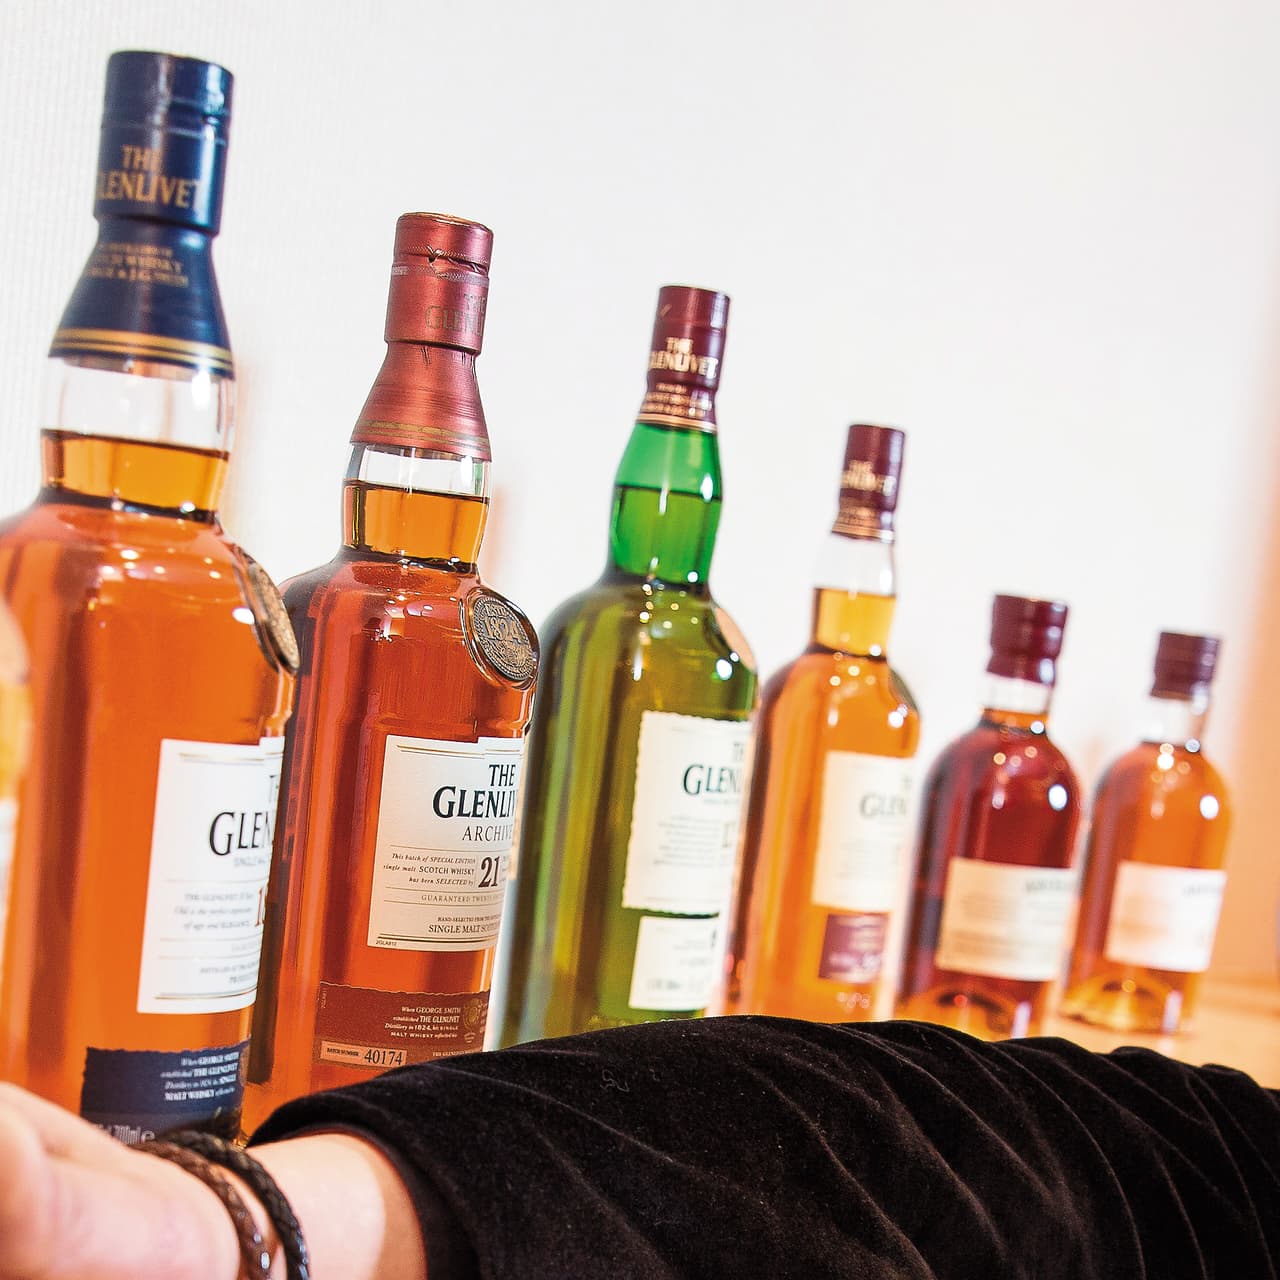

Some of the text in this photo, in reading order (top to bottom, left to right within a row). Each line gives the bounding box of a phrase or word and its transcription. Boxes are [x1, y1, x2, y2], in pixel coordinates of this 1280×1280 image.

[484, 616, 528, 644] 1824
[489, 764, 516, 787] THE
[430, 856, 454, 864] SPECIAL
[383, 864, 400, 872] single
[419, 866, 449, 874] SCOTCH
[450, 867, 475, 875] WHISKY
[478, 856, 501, 888] 21
[421, 894, 470, 903] GUARANTEED
[428, 924, 461, 933] SINGLE
[462, 925, 480, 933] MALT
[416, 1006, 442, 1014] GEORGE
[420, 1015, 432, 1023] THE
[432, 1015, 460, 1023] GLENLIVET
[364, 1048, 403, 1066] 40174
